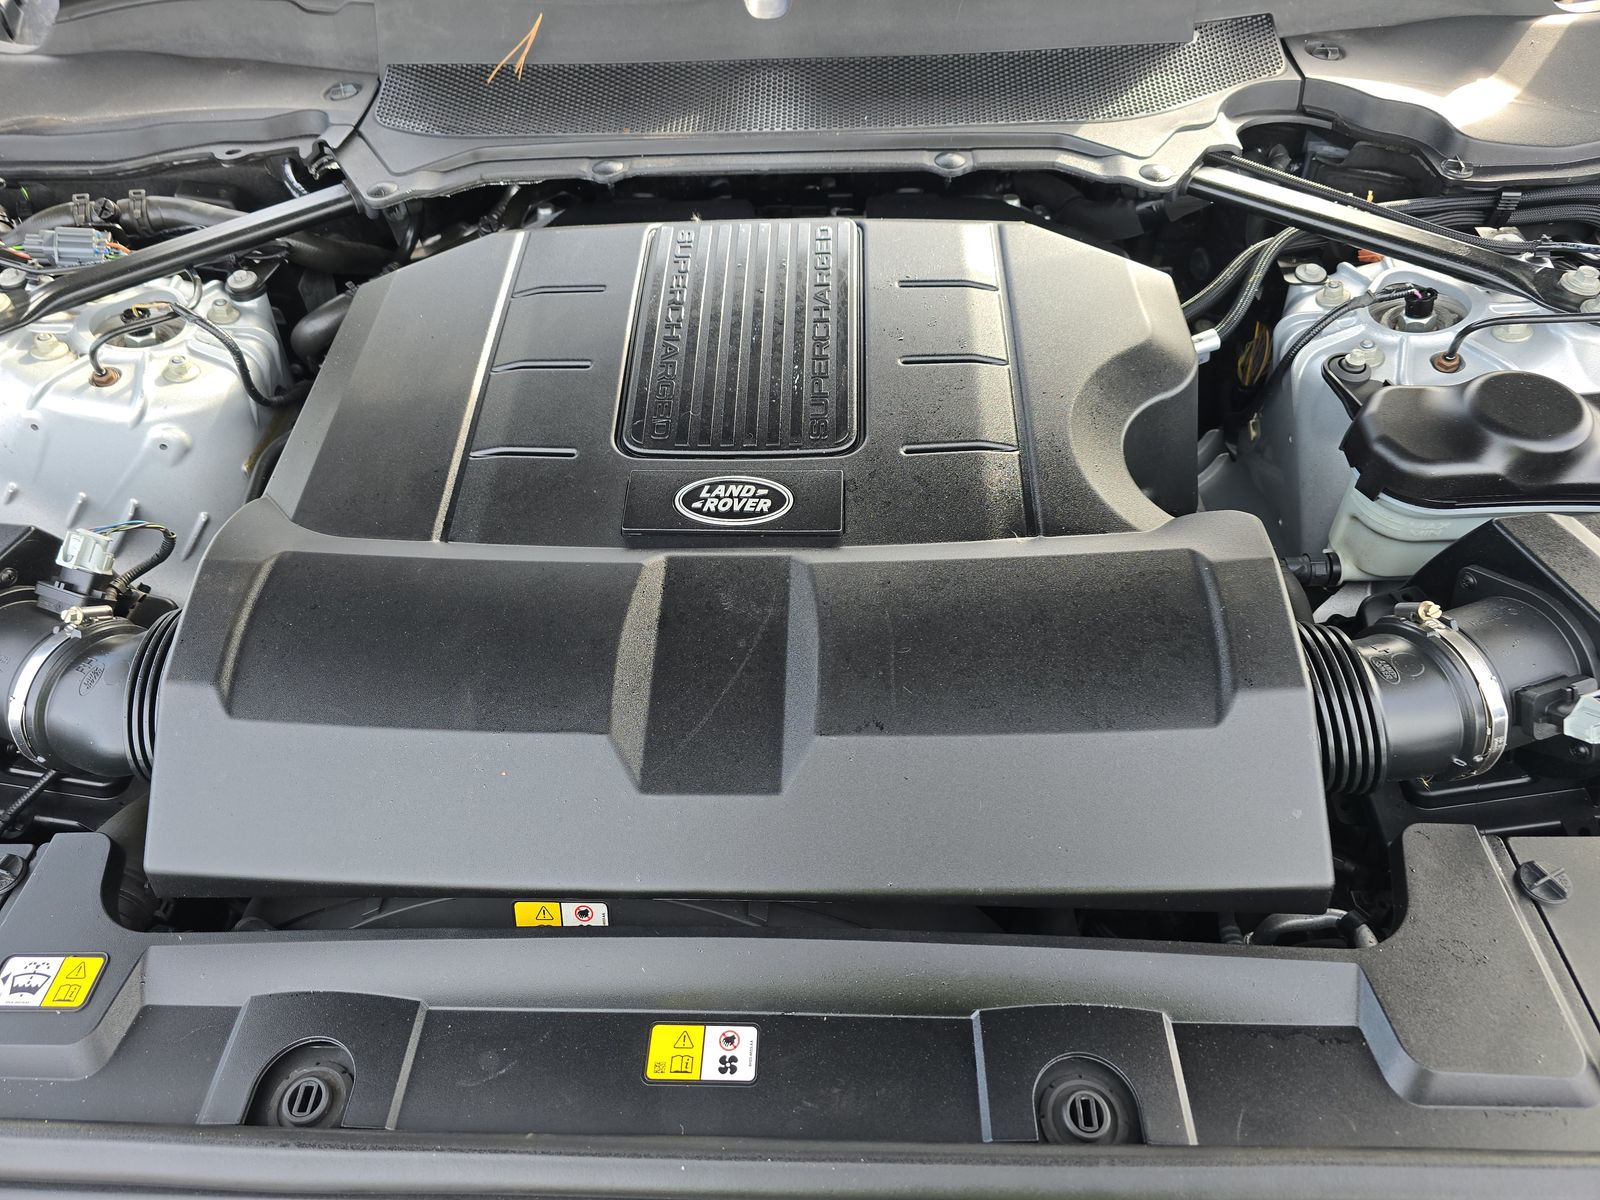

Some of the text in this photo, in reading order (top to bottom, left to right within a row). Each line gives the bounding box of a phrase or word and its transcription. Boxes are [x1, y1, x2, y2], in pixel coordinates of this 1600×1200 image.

[650, 229, 695, 441] SUPERCHARGED
[808, 225, 833, 441] SUPERCHARGED
[700, 484, 757, 498] LAND
[702, 498, 773, 513] ROVER
